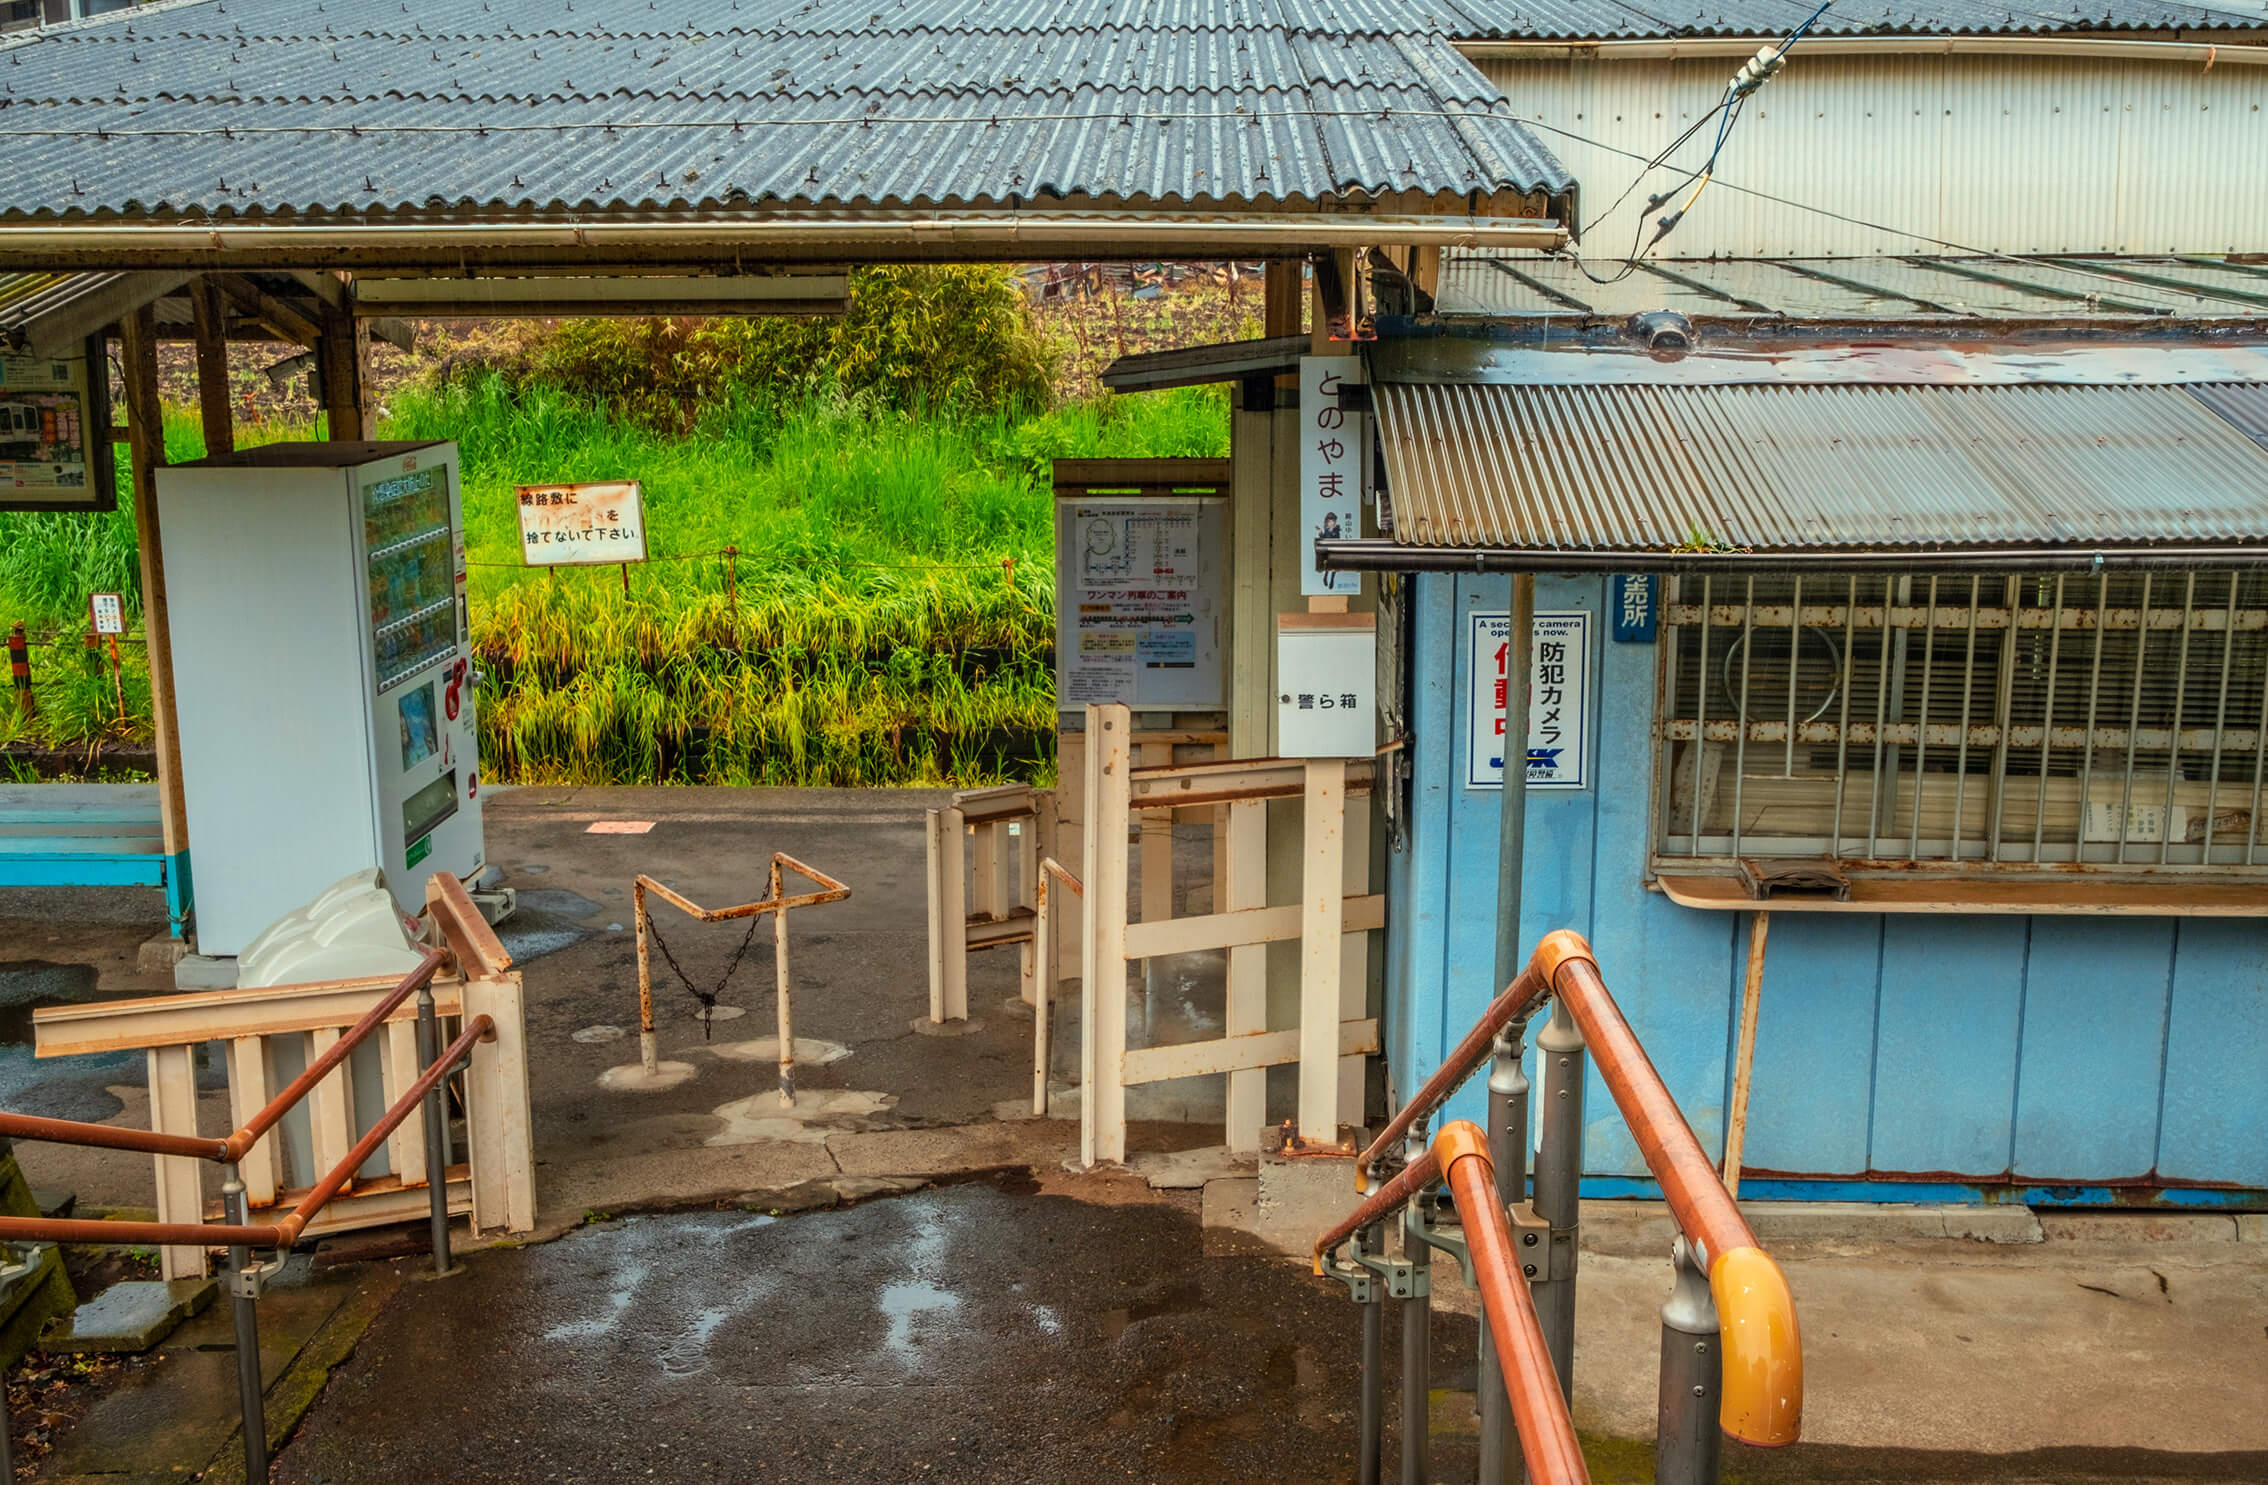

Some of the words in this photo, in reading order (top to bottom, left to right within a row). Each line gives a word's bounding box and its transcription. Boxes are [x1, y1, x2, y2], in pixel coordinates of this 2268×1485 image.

[1317, 370, 1345, 498] とのやま
[520, 492, 577, 505] 線路敷に
[527, 528, 635, 544] 捨てないで下さい
[1087, 591, 1188, 601] ワンマン列車のご案内
[1479, 620, 1487, 628] A
[1539, 641, 1566, 745] 防犯カメラ
[1298, 693, 1357, 710] 警ら箱
